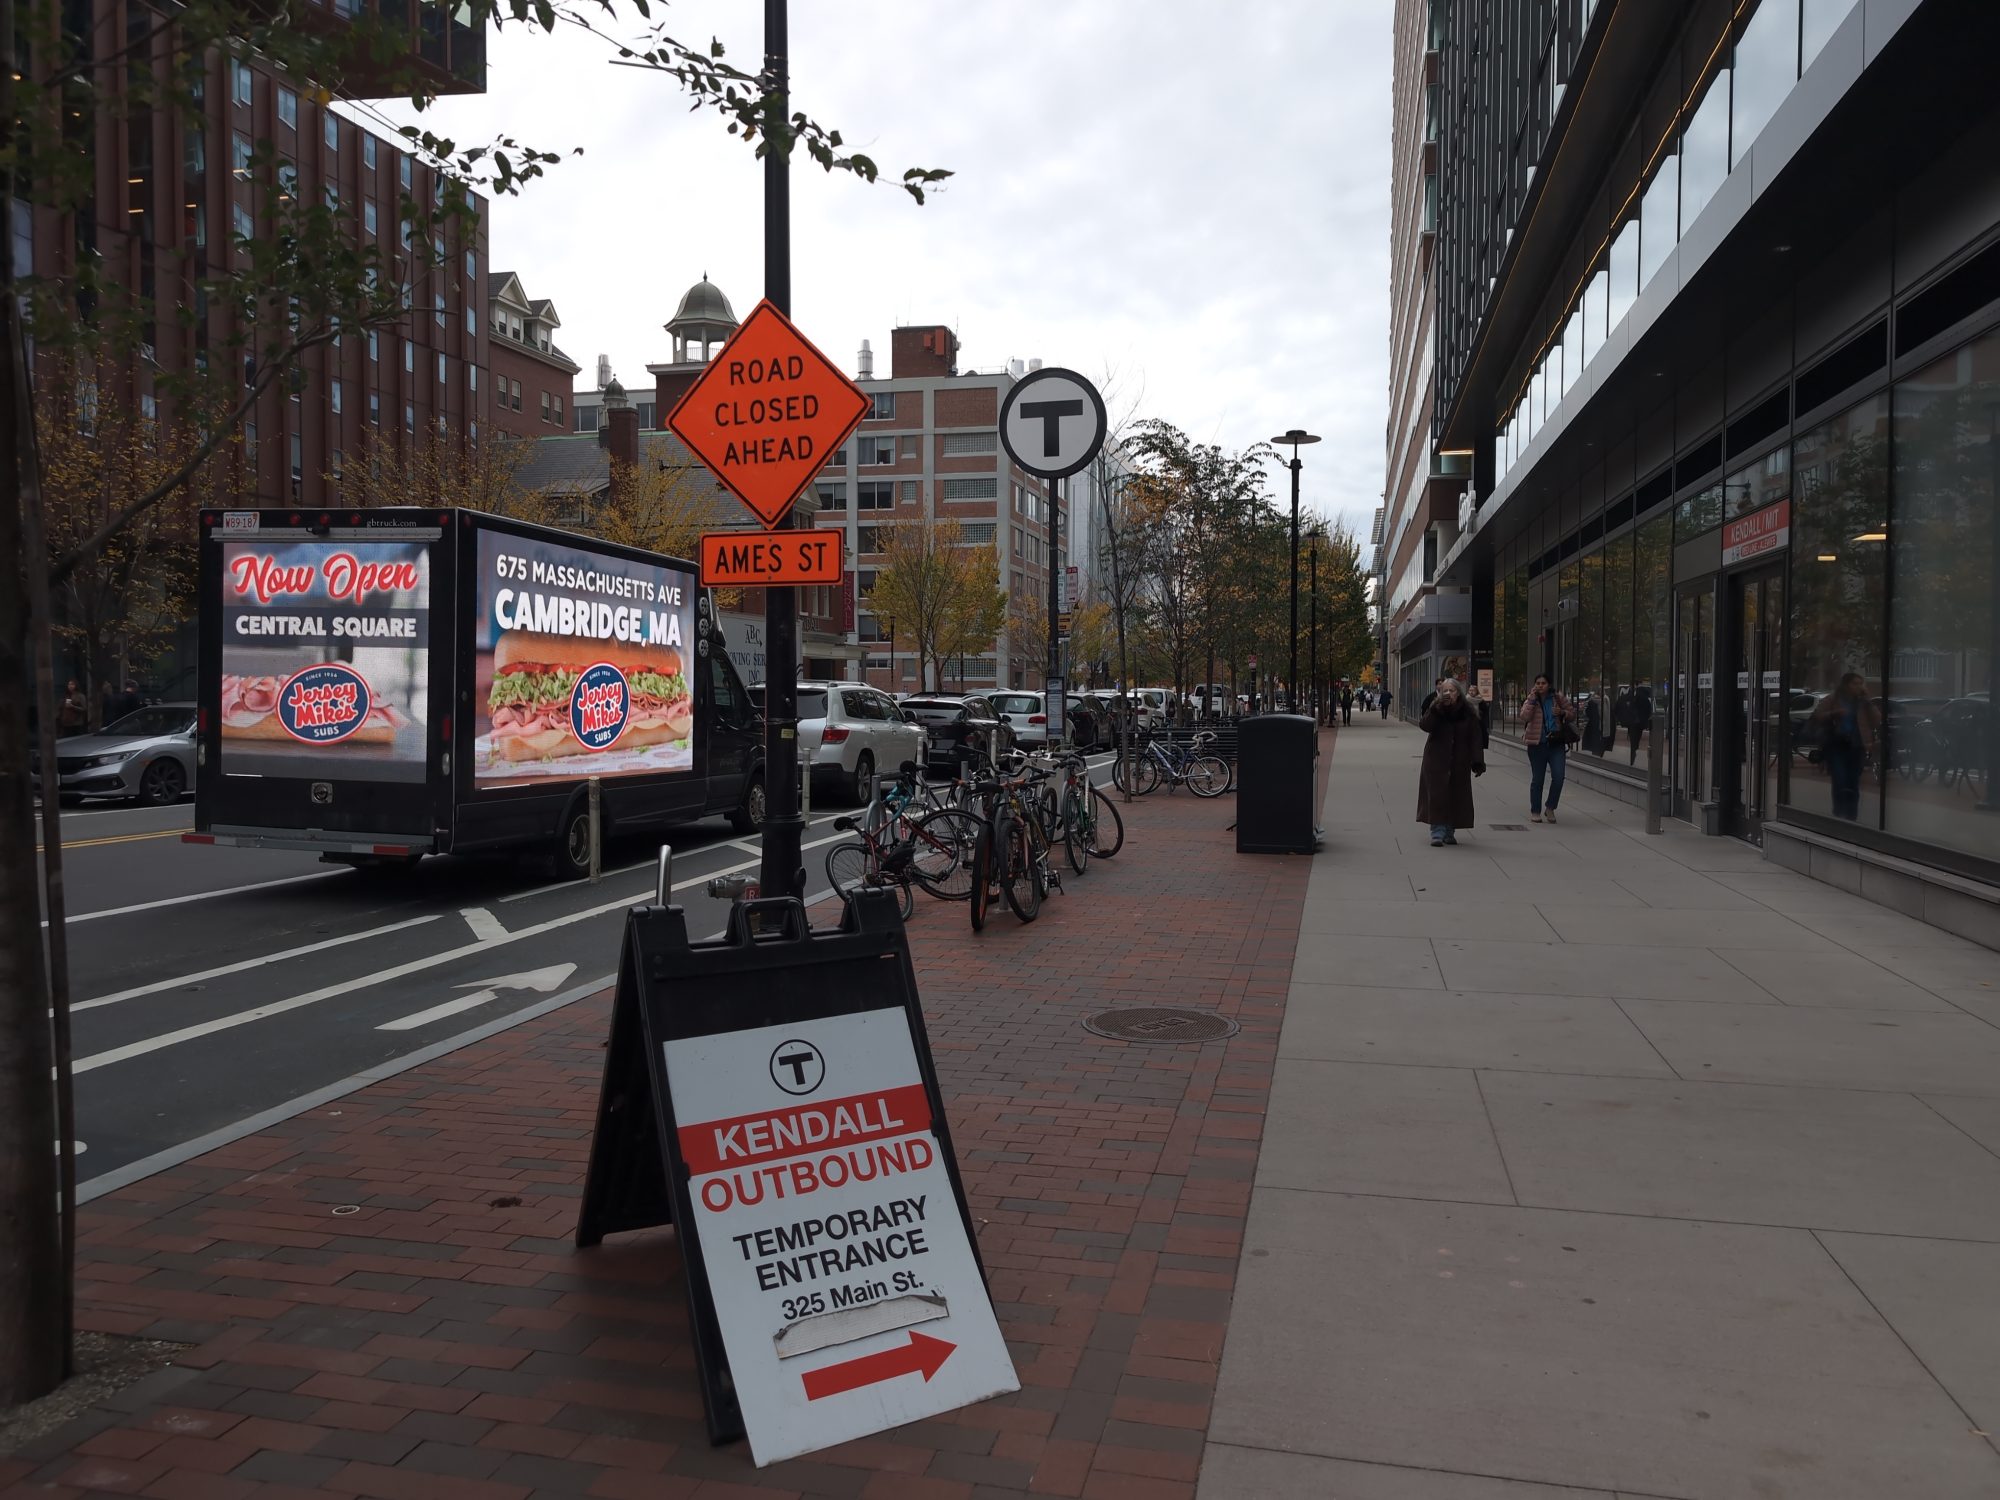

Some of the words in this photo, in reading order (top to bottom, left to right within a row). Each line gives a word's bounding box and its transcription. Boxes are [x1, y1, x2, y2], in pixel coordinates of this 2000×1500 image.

[730, 356, 804, 385] ROAD
[715, 395, 819, 426] CLOSED
[1020, 399, 1083, 457] T
[723, 435, 813, 466] AHEAD
[714, 544, 782, 574] AMES
[798, 543, 827, 572] ST
[231, 555, 315, 604] Now
[323, 553, 418, 605] Open
[496, 554, 527, 580] 675
[532, 560, 655, 601] MASSACHUSETTS
[658, 585, 681, 606] AVE
[235, 615, 327, 635] CENTRAL
[332, 616, 417, 638] SQUARE
[495, 588, 646, 647] CAMBRIDGE,
[649, 611, 682, 647] MA
[744, 624, 761, 644] ABC
[729, 652, 751, 666] OVING
[288, 682, 357, 706] Jersey
[577, 681, 622, 710] Jersey
[294, 701, 359, 729] Mike's
[582, 701, 623, 735] Mike's
[313, 725, 340, 738] SUBS
[594, 729, 611, 743] SUBS
[778, 1052, 813, 1085] T
[713, 1098, 904, 1161] KENDALL
[701, 1138, 933, 1212] OUTBOUND
[733, 1195, 927, 1260] TEMPORARY
[756, 1228, 929, 1291] ENTRANCE
[782, 1294, 825, 1320] 325
[830, 1279, 888, 1309] Main
[892, 1270, 924, 1293] St.
